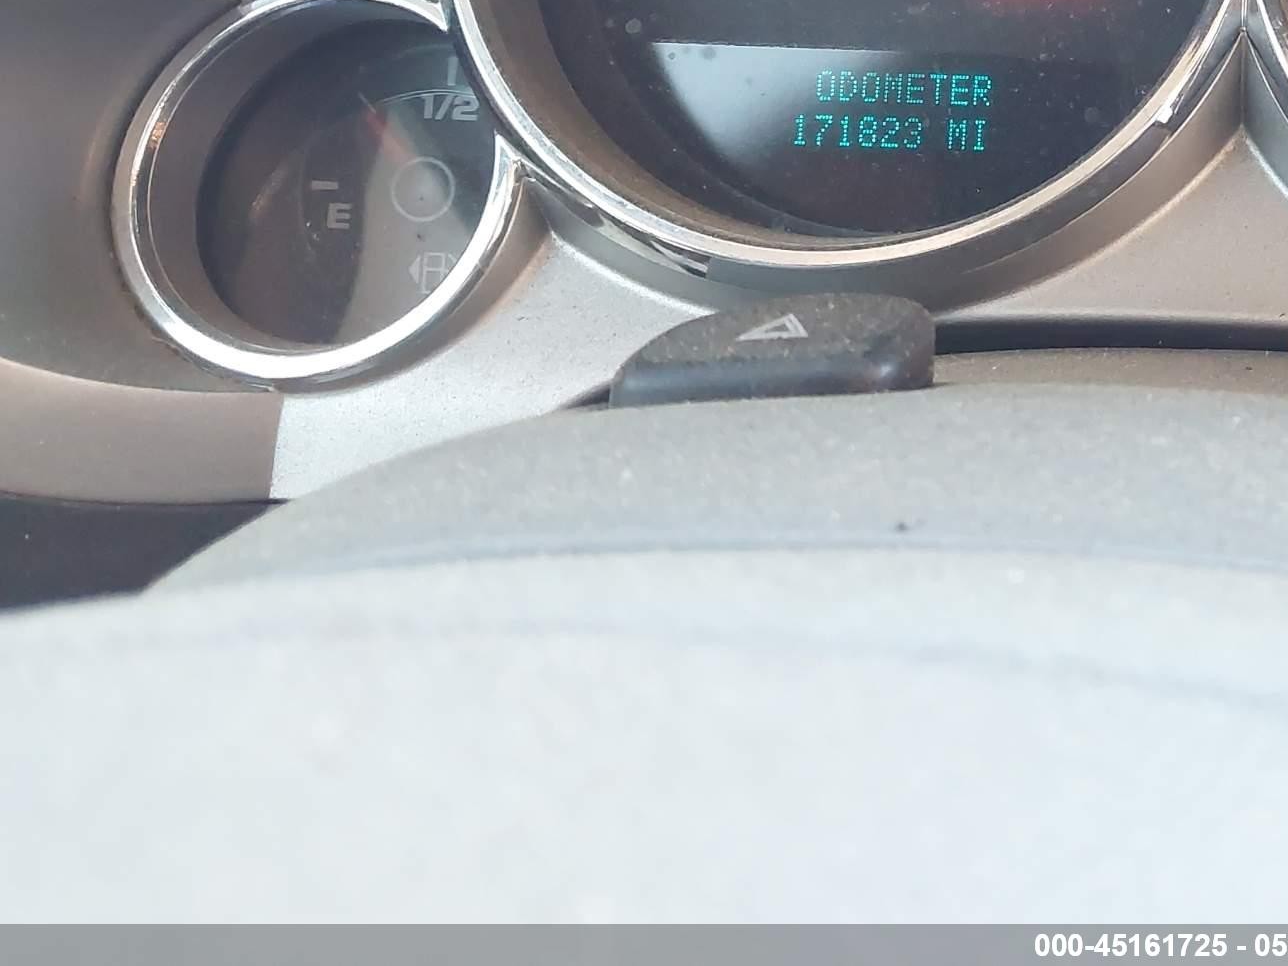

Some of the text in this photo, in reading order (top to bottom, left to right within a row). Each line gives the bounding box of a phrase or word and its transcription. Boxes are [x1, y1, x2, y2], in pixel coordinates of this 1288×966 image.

[816, 70, 992, 106] ODOMETER
[420, 94, 480, 121] 1/2
[794, 114, 986, 151] 171823 MI
[326, 203, 352, 229] E
